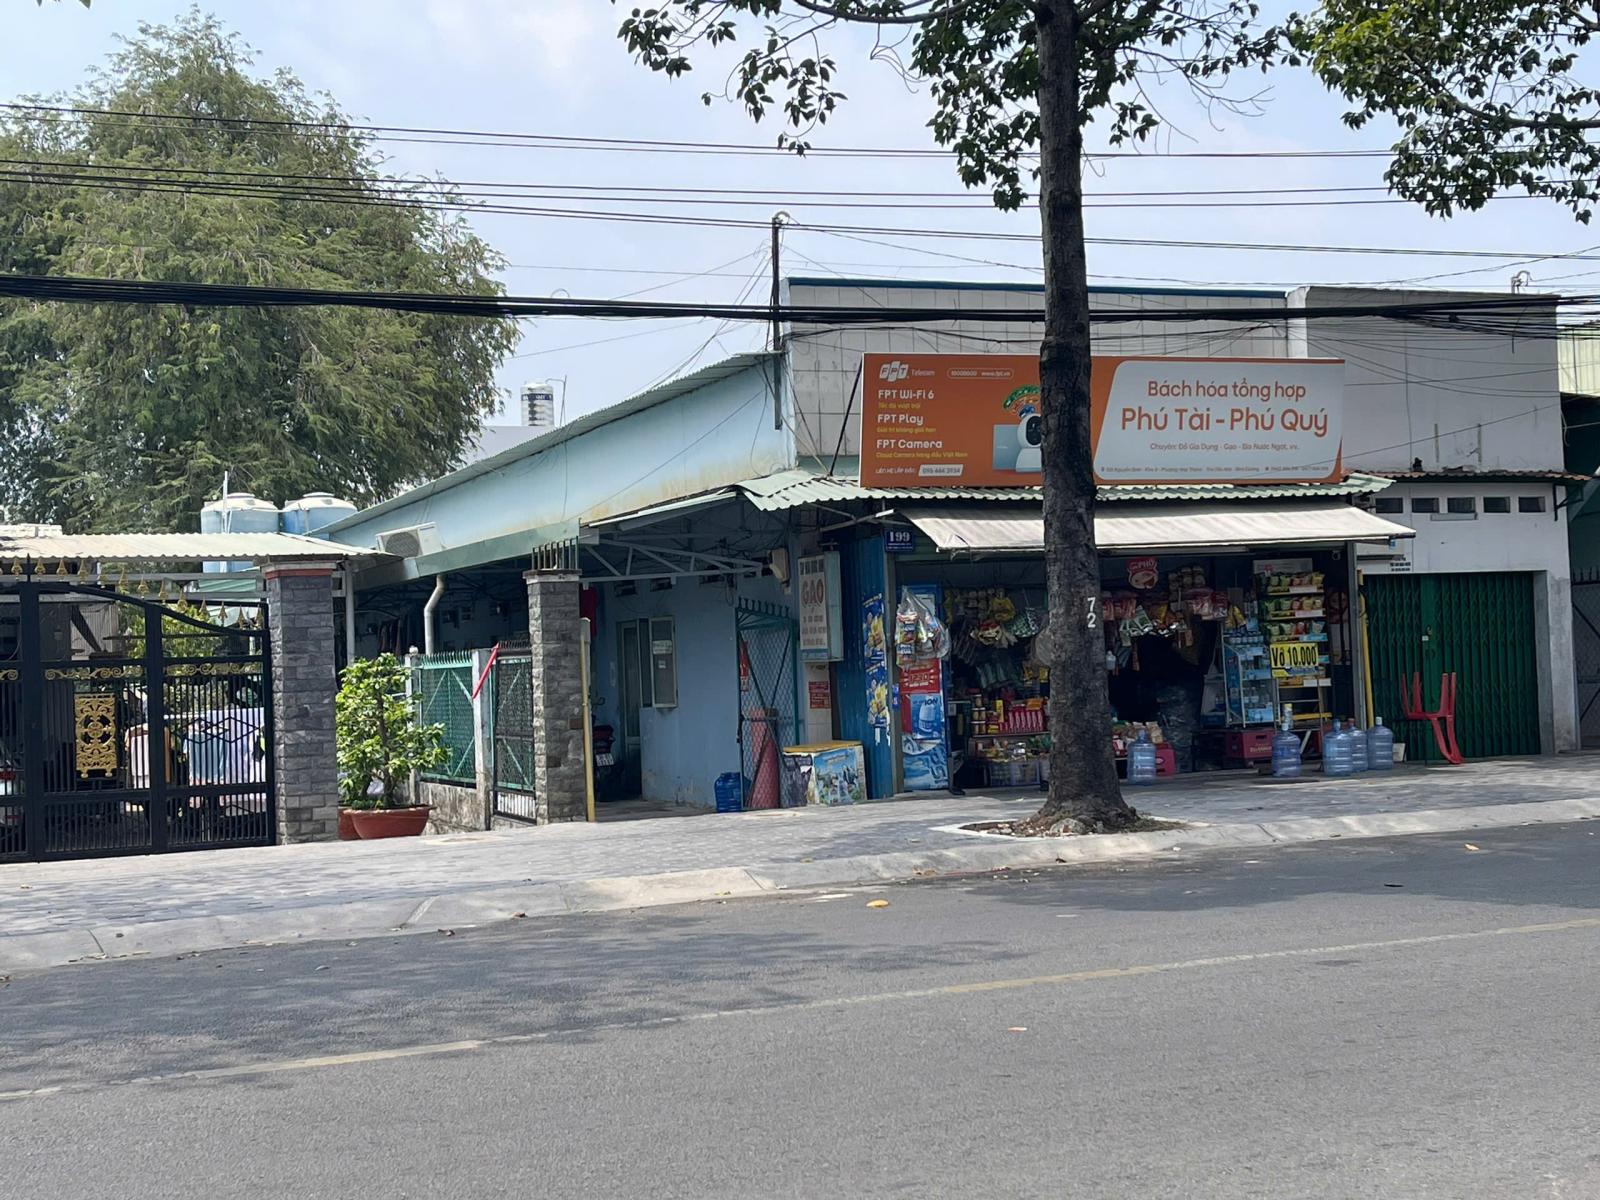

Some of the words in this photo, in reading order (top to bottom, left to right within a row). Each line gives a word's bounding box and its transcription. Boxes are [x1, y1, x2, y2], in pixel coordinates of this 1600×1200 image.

[880, 361, 908, 382] FPT
[911, 368, 935, 377] Telecom
[878, 389, 897, 400] FPT
[927, 389, 935, 400] 6
[1147, 379, 1192, 397] Bách
[1196, 379, 1229, 398] hóa
[1231, 377, 1271, 402] tổng
[1274, 380, 1306, 402] hợp
[877, 413, 896, 424] FPT
[899, 413, 924, 426] Play
[1121, 406, 1168, 431] Phú
[1174, 406, 1211, 431] Tài
[1229, 408, 1275, 431] Phú
[1280, 407, 1328, 438] Quý
[876, 439, 896, 449] FPT
[898, 439, 943, 449] Camera
[890, 531, 911, 542] 199
[1087, 596, 1096, 628] 72
[1287, 645, 1317, 667] 10.000
